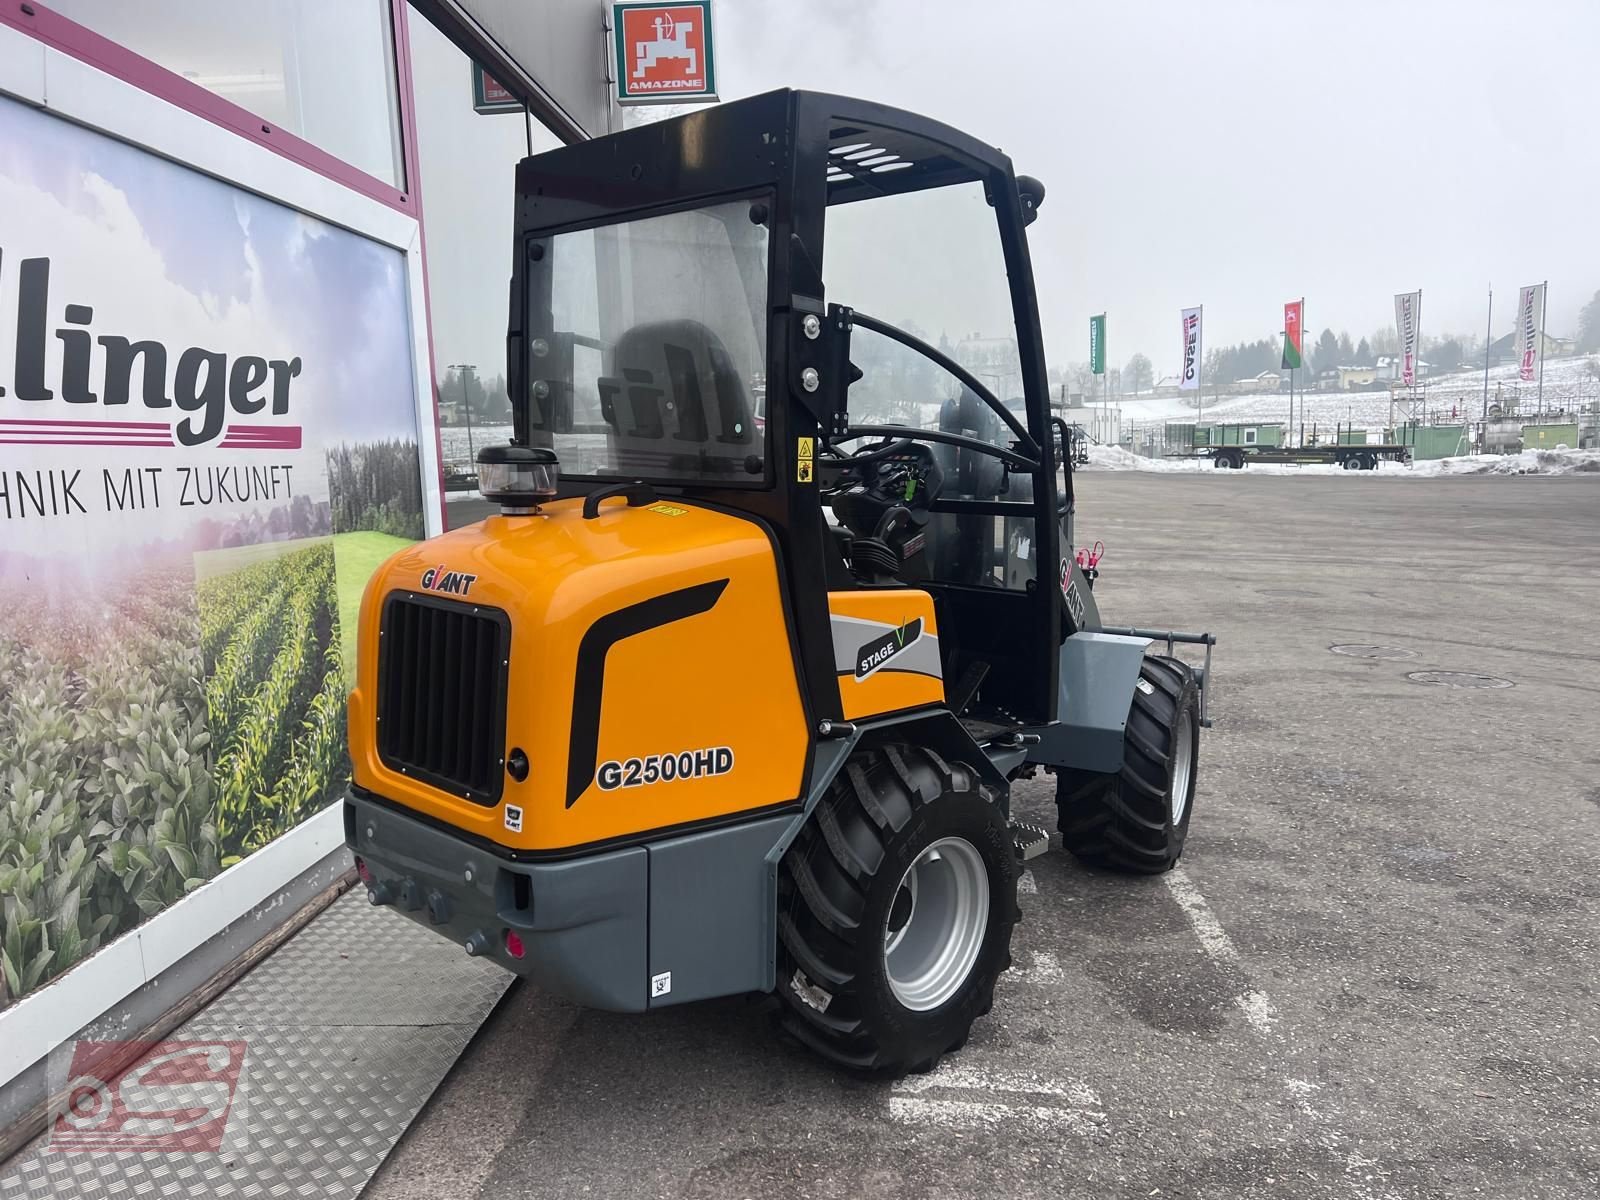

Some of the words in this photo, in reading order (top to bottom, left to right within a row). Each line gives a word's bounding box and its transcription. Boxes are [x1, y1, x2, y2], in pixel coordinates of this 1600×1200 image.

[629, 79, 703, 90] AMAZONE
[0, 247, 302, 446] linger
[103, 467, 162, 512] MIT
[176, 465, 293, 506] ZUKUNFT
[861, 642, 895, 672] STAGE
[597, 746, 734, 791] G2500HD
